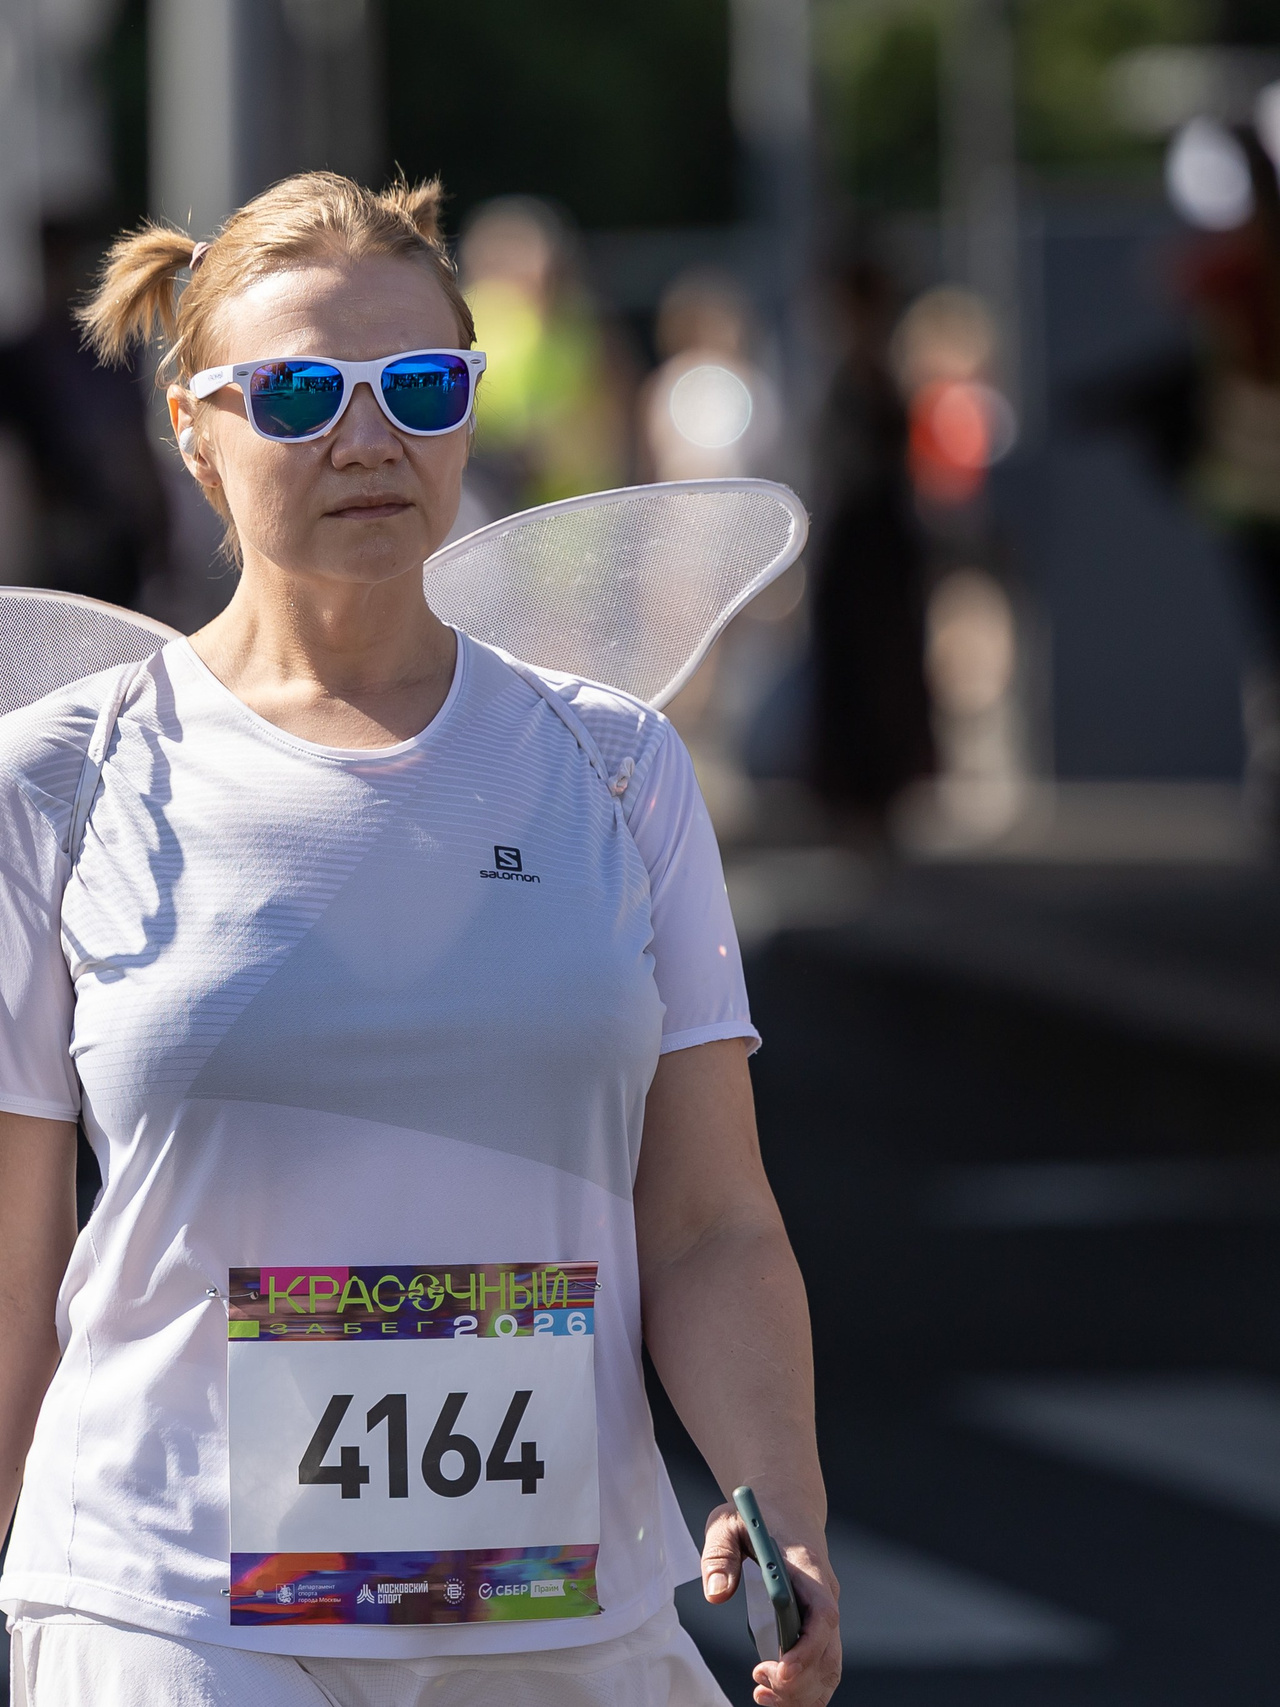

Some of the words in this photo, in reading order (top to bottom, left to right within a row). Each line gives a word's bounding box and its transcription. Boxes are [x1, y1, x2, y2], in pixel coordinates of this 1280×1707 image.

[268, 1266, 568, 1314] КРАСОЧНЫЙ
[269, 1321, 434, 1335] ЗАБЕГ
[453, 1311, 587, 1339] 2026
[298, 1390, 545, 1499] 4164
[377, 1580, 429, 1594] МОСКОВСКИЙ
[496, 1584, 529, 1596] СБЕР
[534, 1583, 559, 1594] Прайм
[377, 1593, 402, 1604] СПОРТ
